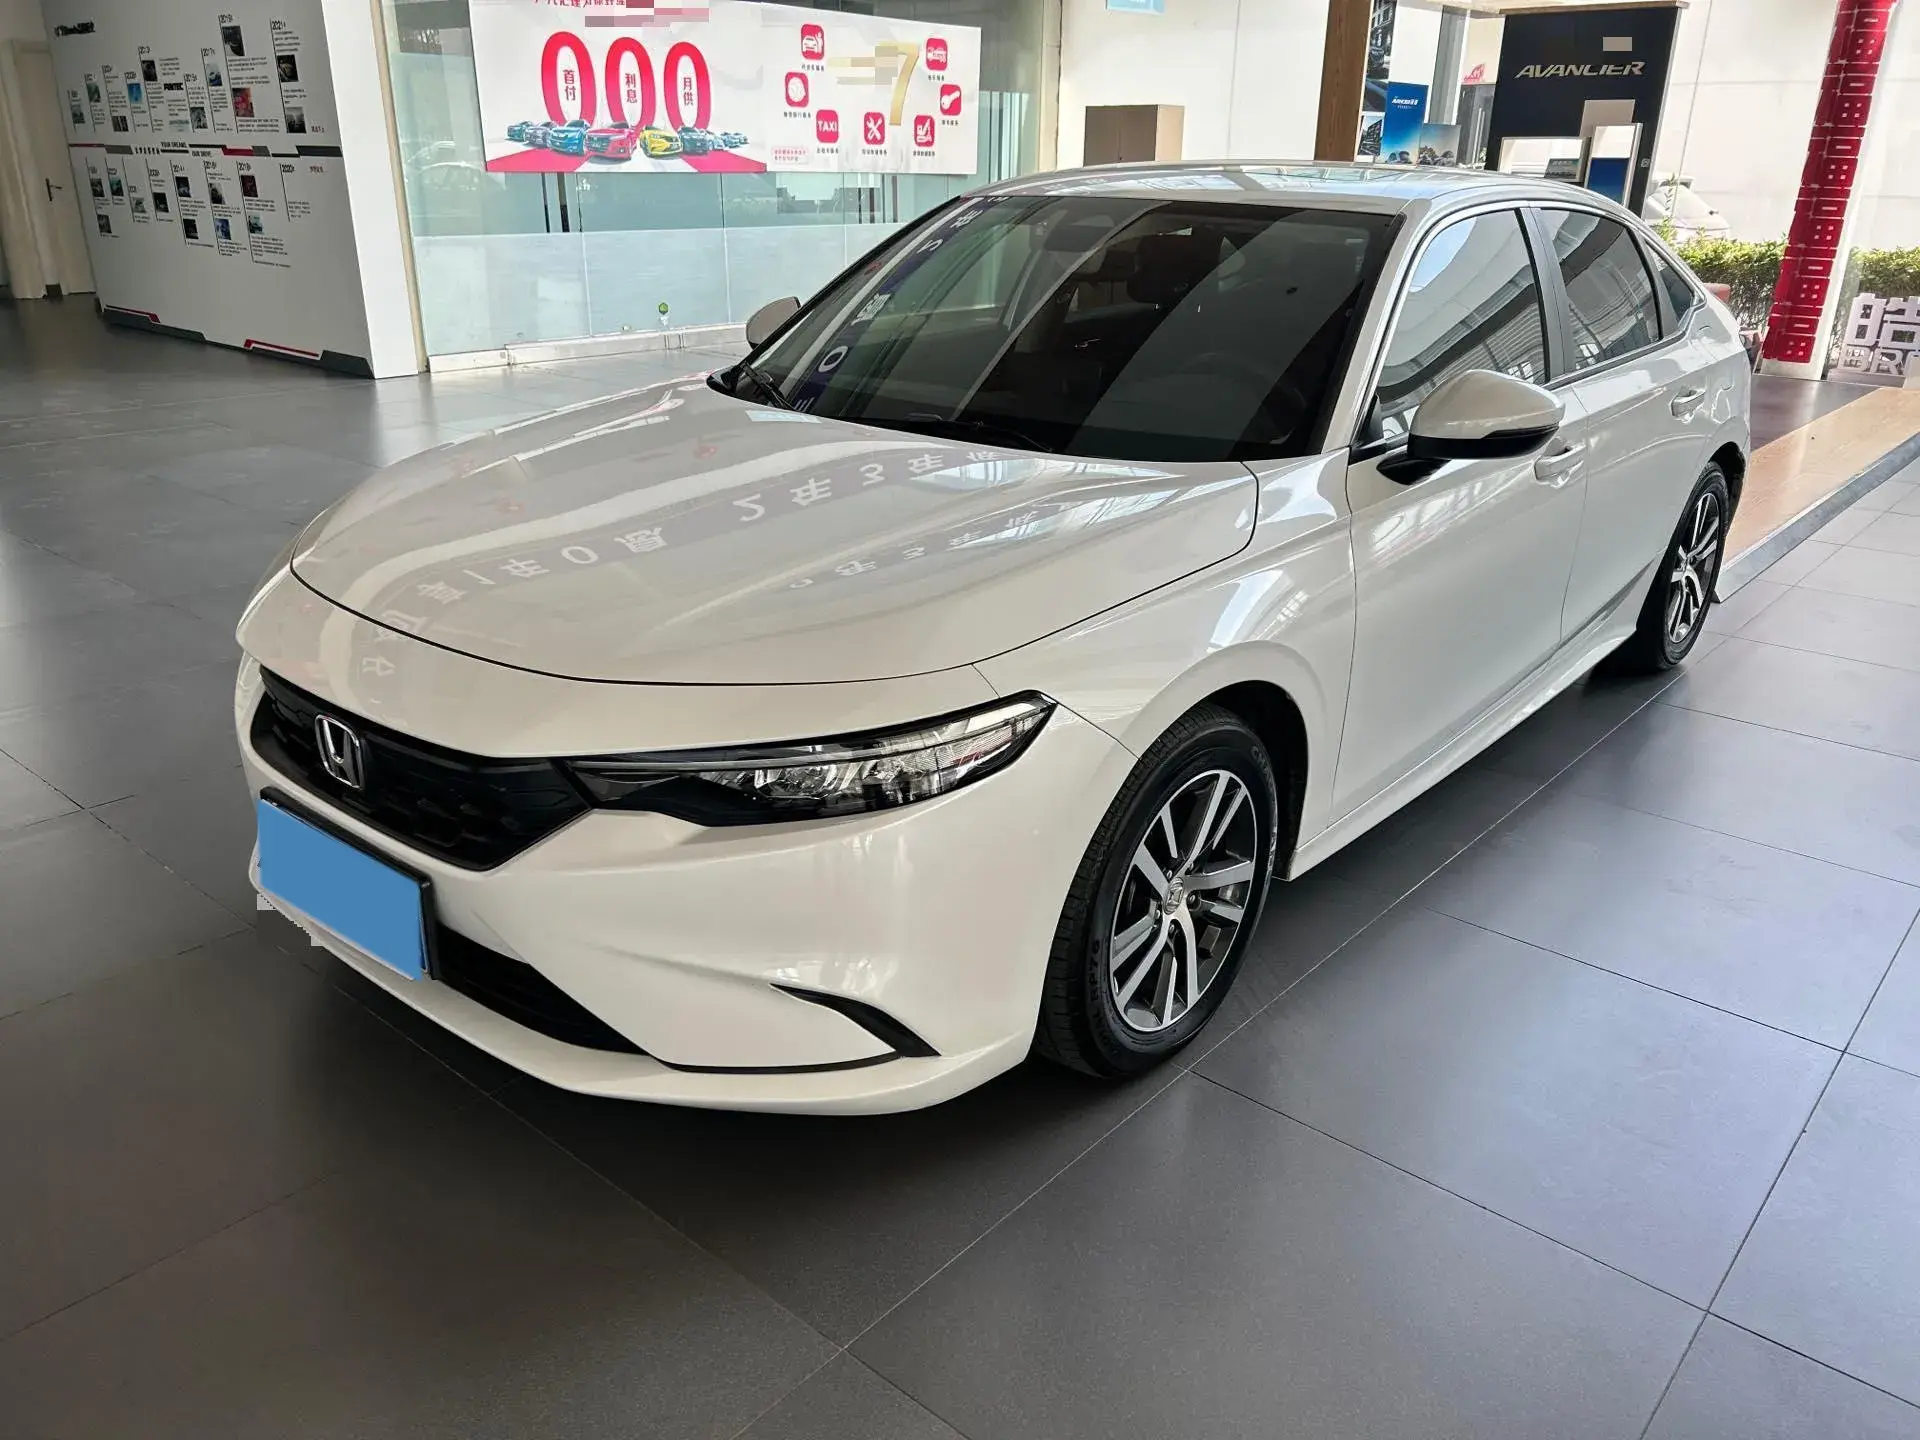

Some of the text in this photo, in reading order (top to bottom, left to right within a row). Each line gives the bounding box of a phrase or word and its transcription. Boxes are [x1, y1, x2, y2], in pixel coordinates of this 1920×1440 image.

[563, 69, 577, 101] 首付
[624, 72, 638, 104] 利息
[683, 77, 694, 106] 月供
[818, 121, 838, 132] TAXI
